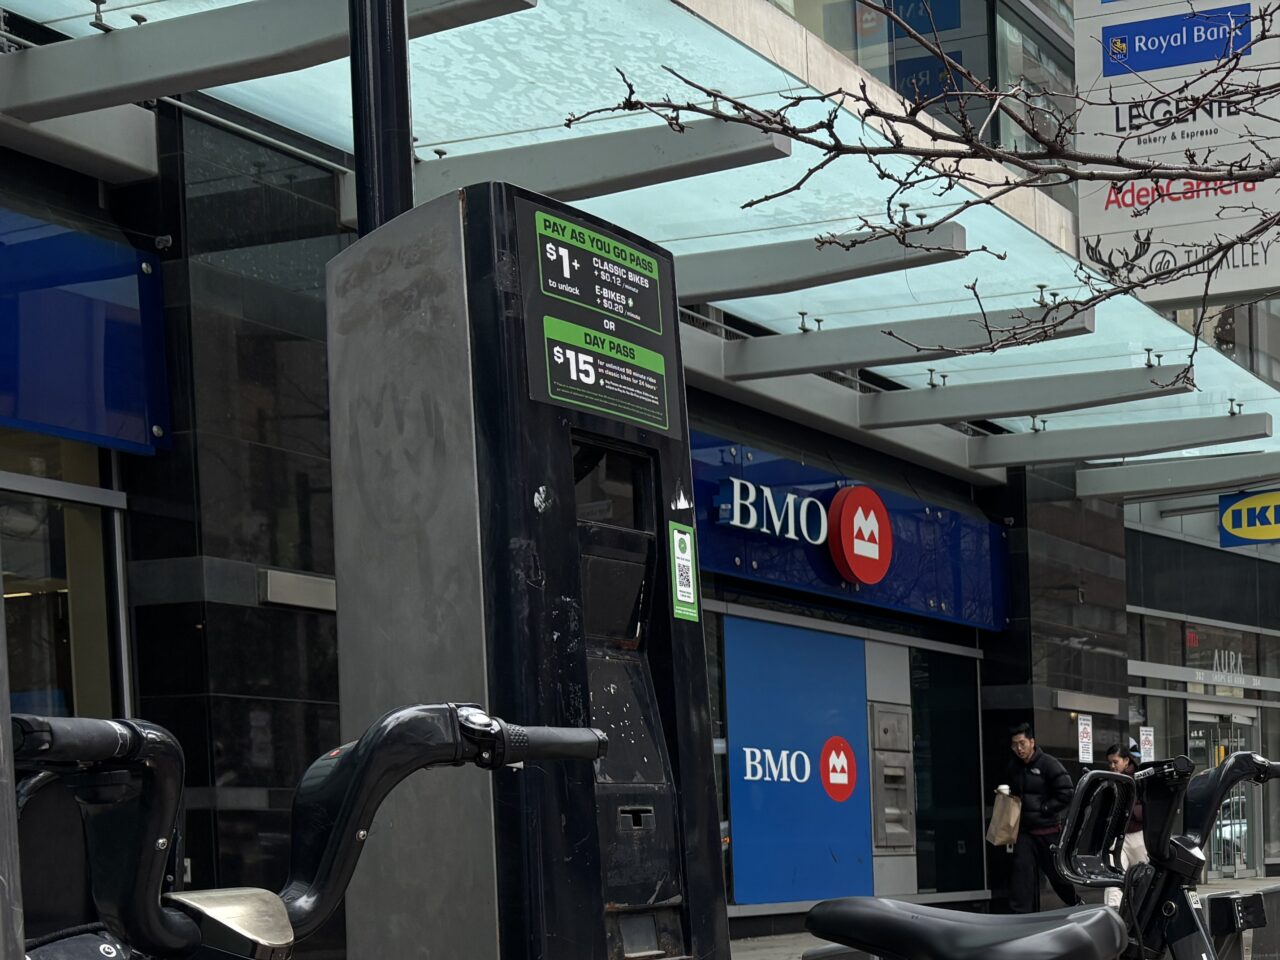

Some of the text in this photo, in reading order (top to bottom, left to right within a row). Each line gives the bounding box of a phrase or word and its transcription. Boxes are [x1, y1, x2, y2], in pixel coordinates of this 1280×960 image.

[1135, 24, 1243, 54] Royal Bank
[1137, 127, 1219, 145] Bakery & Espresso
[543, 218, 654, 274] PAY AS YOU GO PASS
[548, 279, 581, 295] to unlock
[592, 257, 650, 289] CLASSIC BIKES
[600, 271, 622, 286] $0.12
[595, 285, 627, 305] E-BIKES
[602, 298, 624, 314] $0.20
[603, 319, 616, 331] OR
[583, 331, 636, 360] DAY PASS
[553, 345, 596, 385] $15
[728, 476, 828, 546] BMO
[1212, 648, 1244, 675] AURA
[742, 747, 811, 783] BMO
